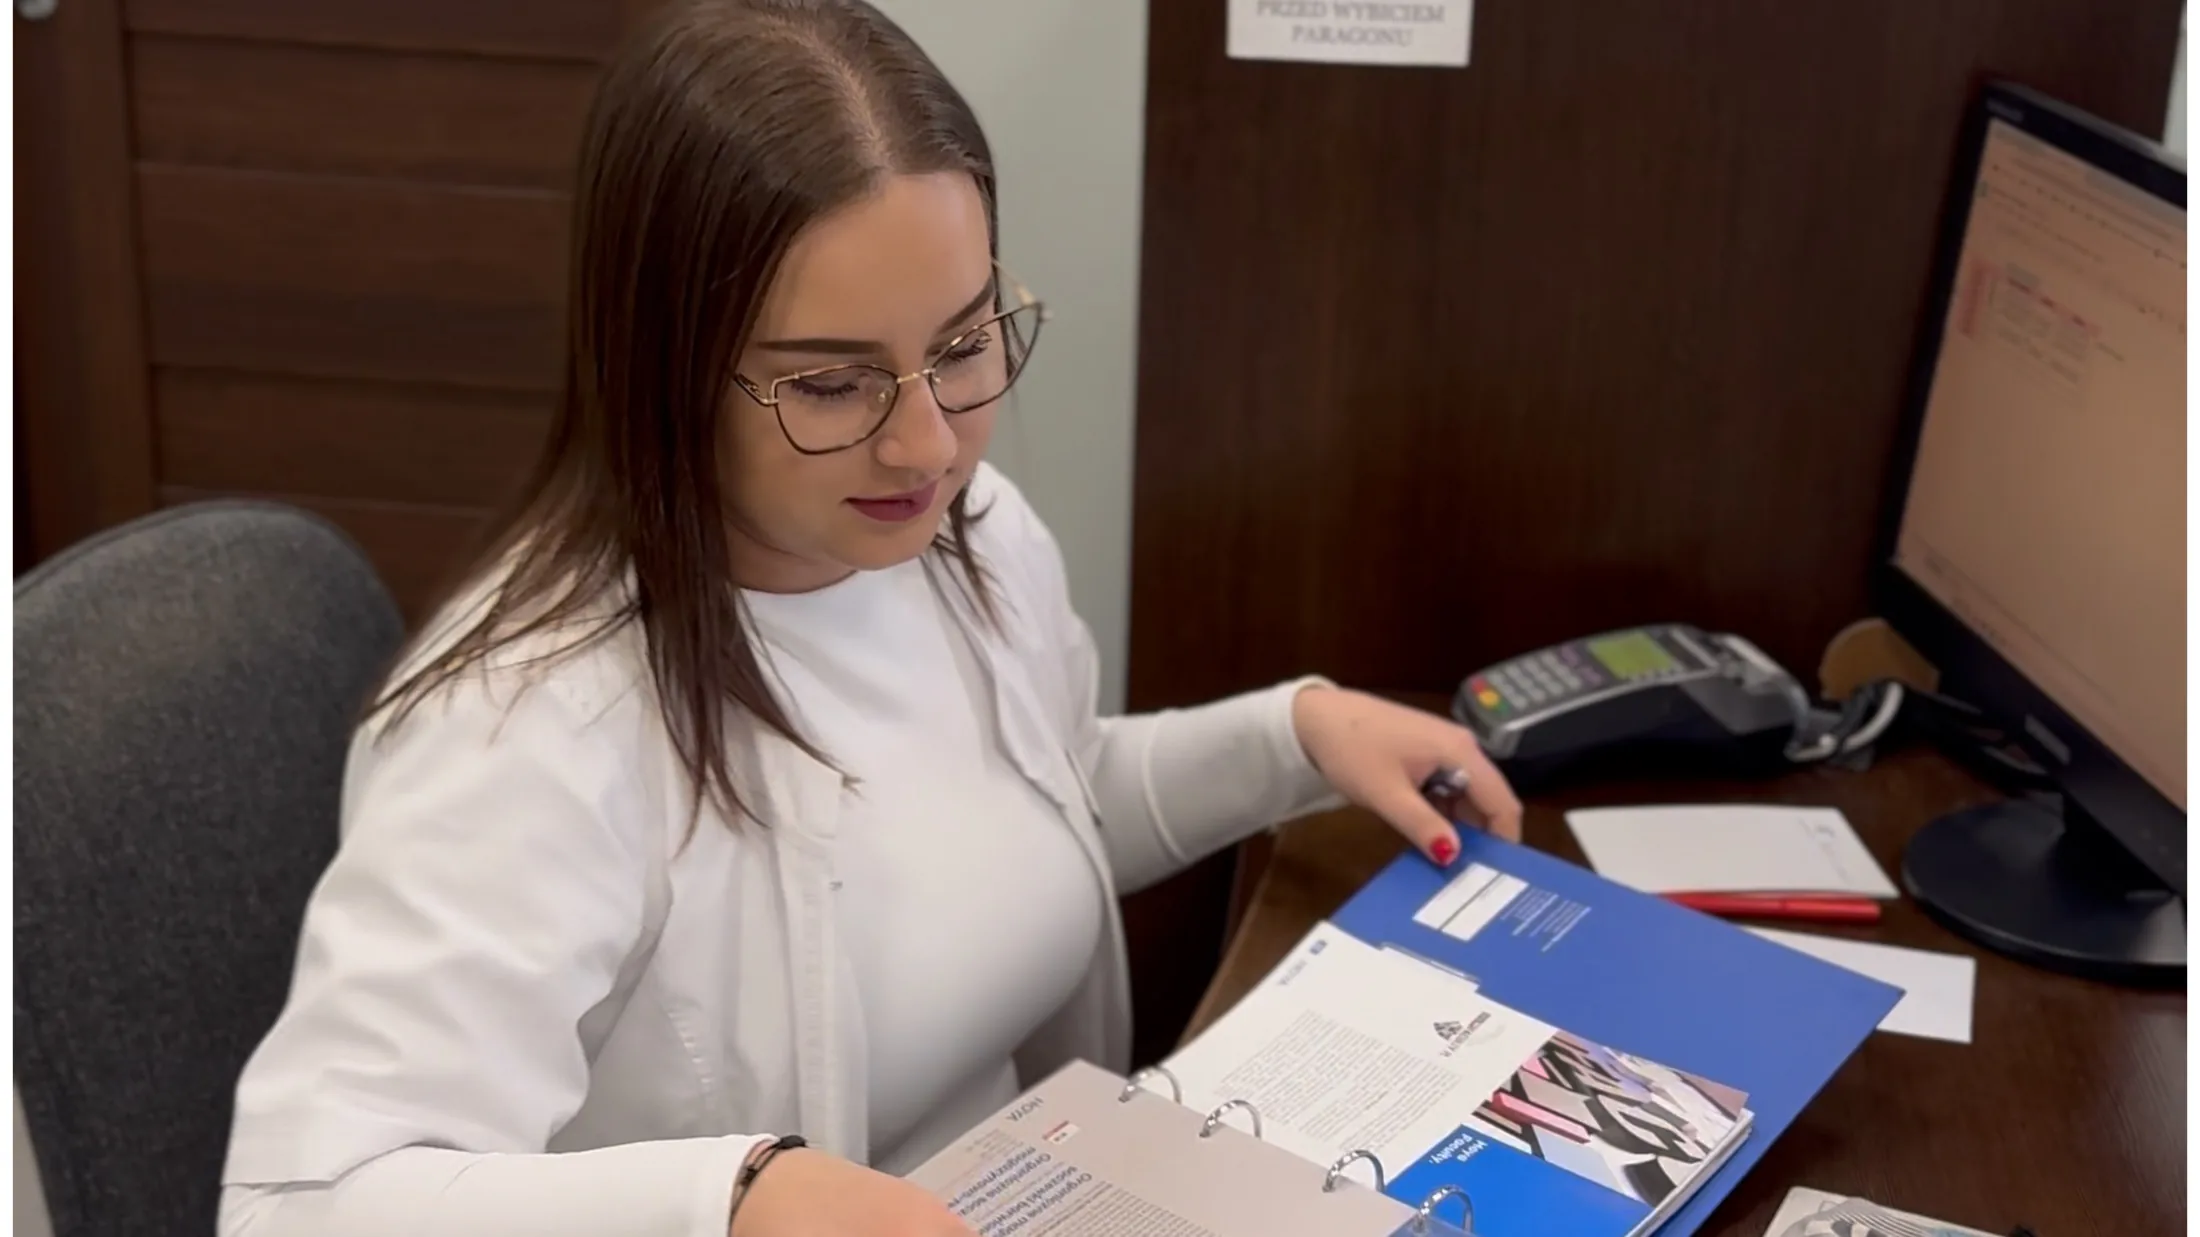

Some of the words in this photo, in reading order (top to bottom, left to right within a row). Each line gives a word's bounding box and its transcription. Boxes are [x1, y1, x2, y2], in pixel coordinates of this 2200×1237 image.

[1291, 25, 1414, 46] PARAGONU
[1006, 1097, 1044, 1122] HOYA
[1457, 1139, 1488, 1163] Hoya
[986, 1152, 1052, 1197] Organiczne
[1027, 1172, 1093, 1218] Organiczne
